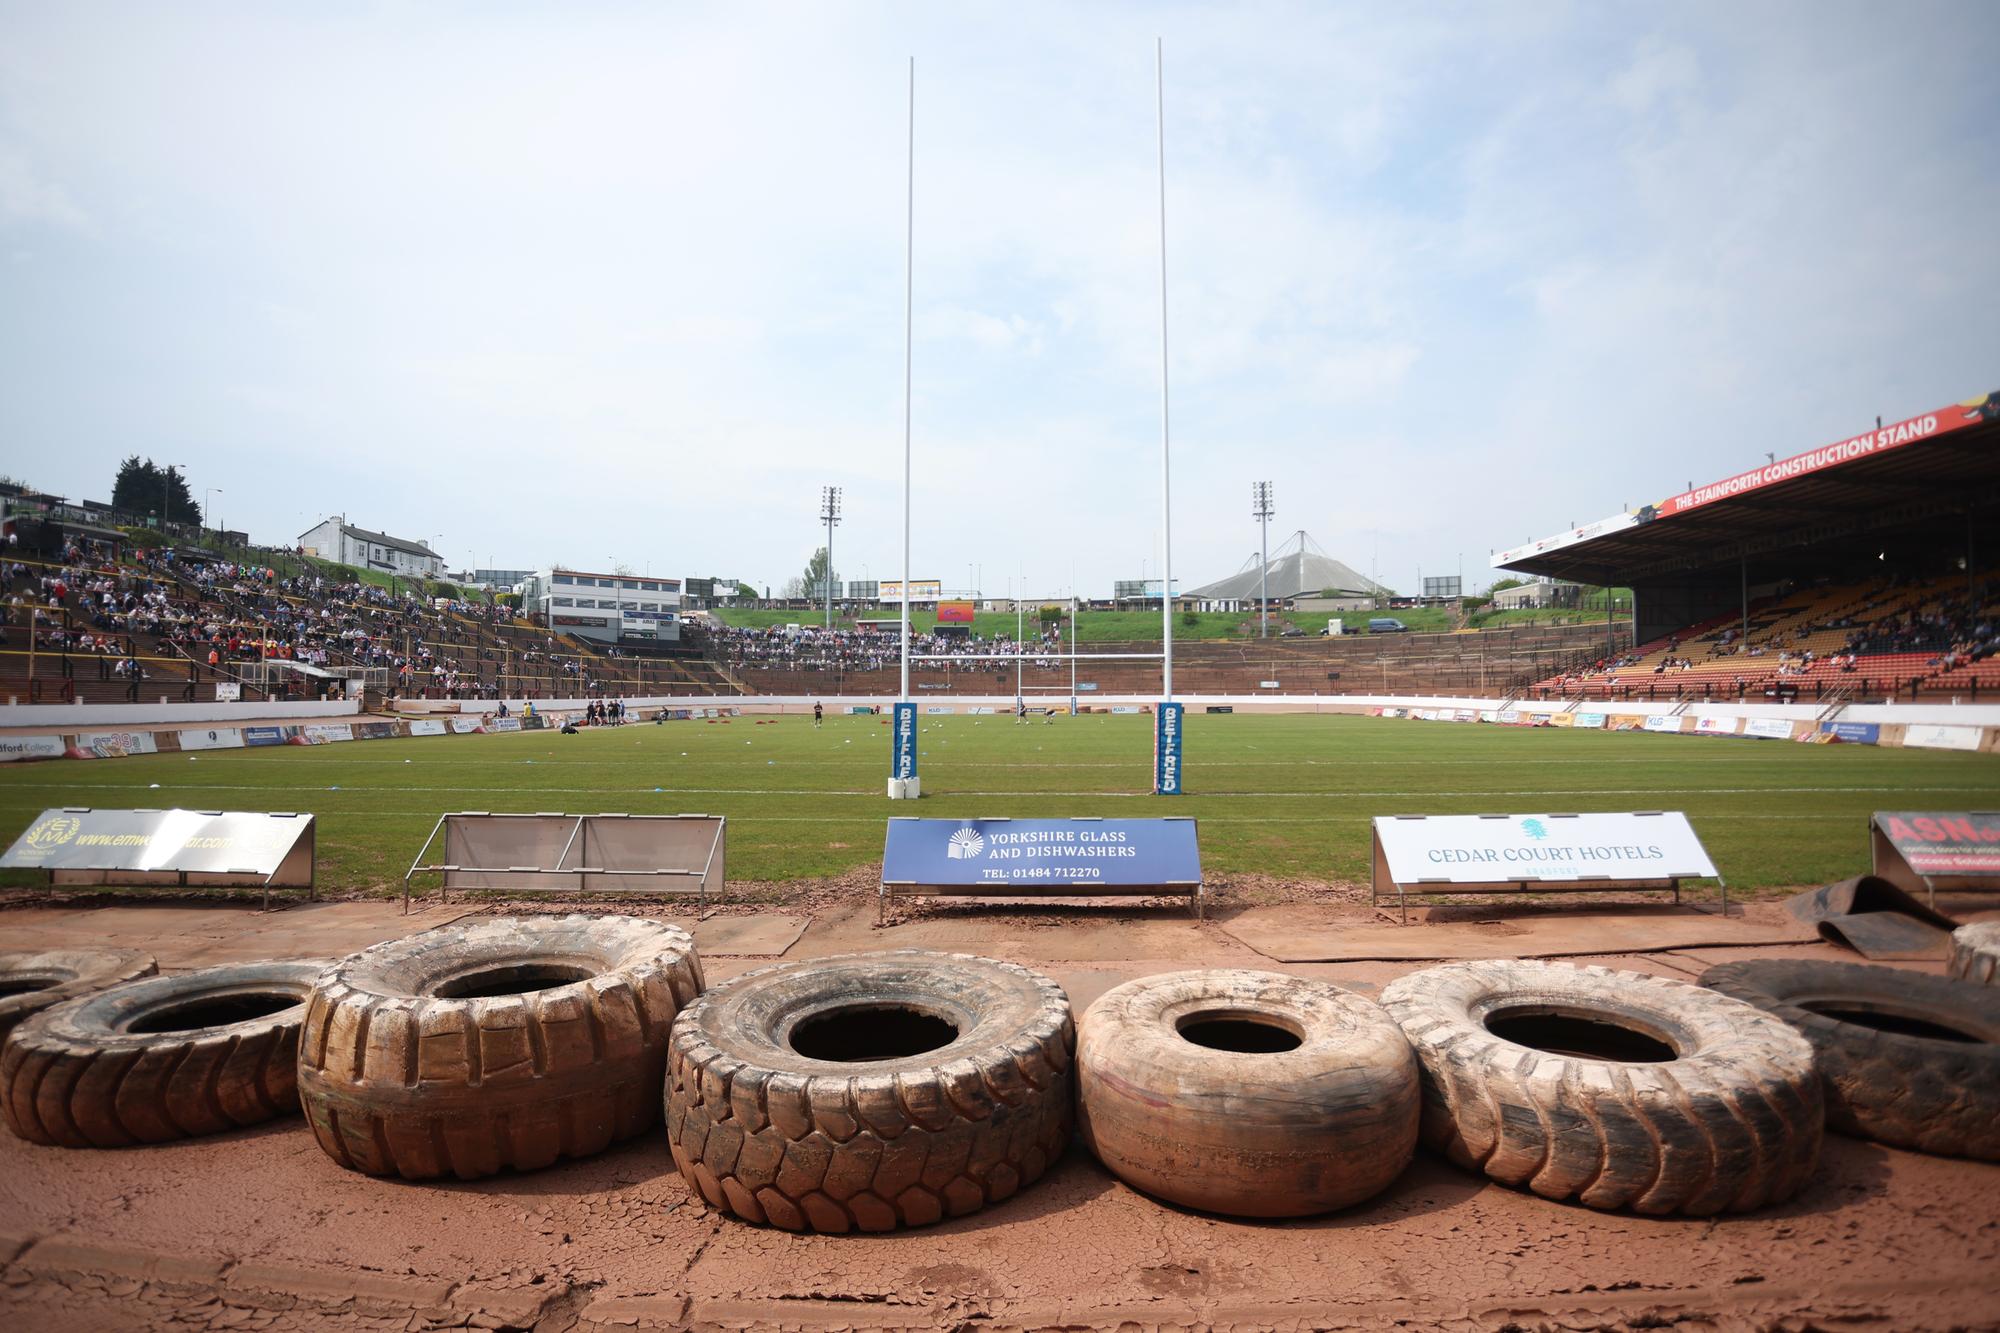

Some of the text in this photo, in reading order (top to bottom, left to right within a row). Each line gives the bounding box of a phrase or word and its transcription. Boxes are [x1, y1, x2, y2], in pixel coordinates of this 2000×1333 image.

[1675, 415, 1937, 510] THE STAINFORTH CONSTRUCTION STAND
[24, 742, 55, 753] College
[900, 708, 912, 779] BETFRE
[1163, 707, 1176, 791] BETFRED
[990, 831, 1126, 845] YORKSHIRE GLASS
[989, 846, 1136, 859] AND DISHWASHERS
[1428, 845, 1664, 863] CEDAR COURT HOTELS
[983, 867, 1100, 878] TEL: 01484 712270
